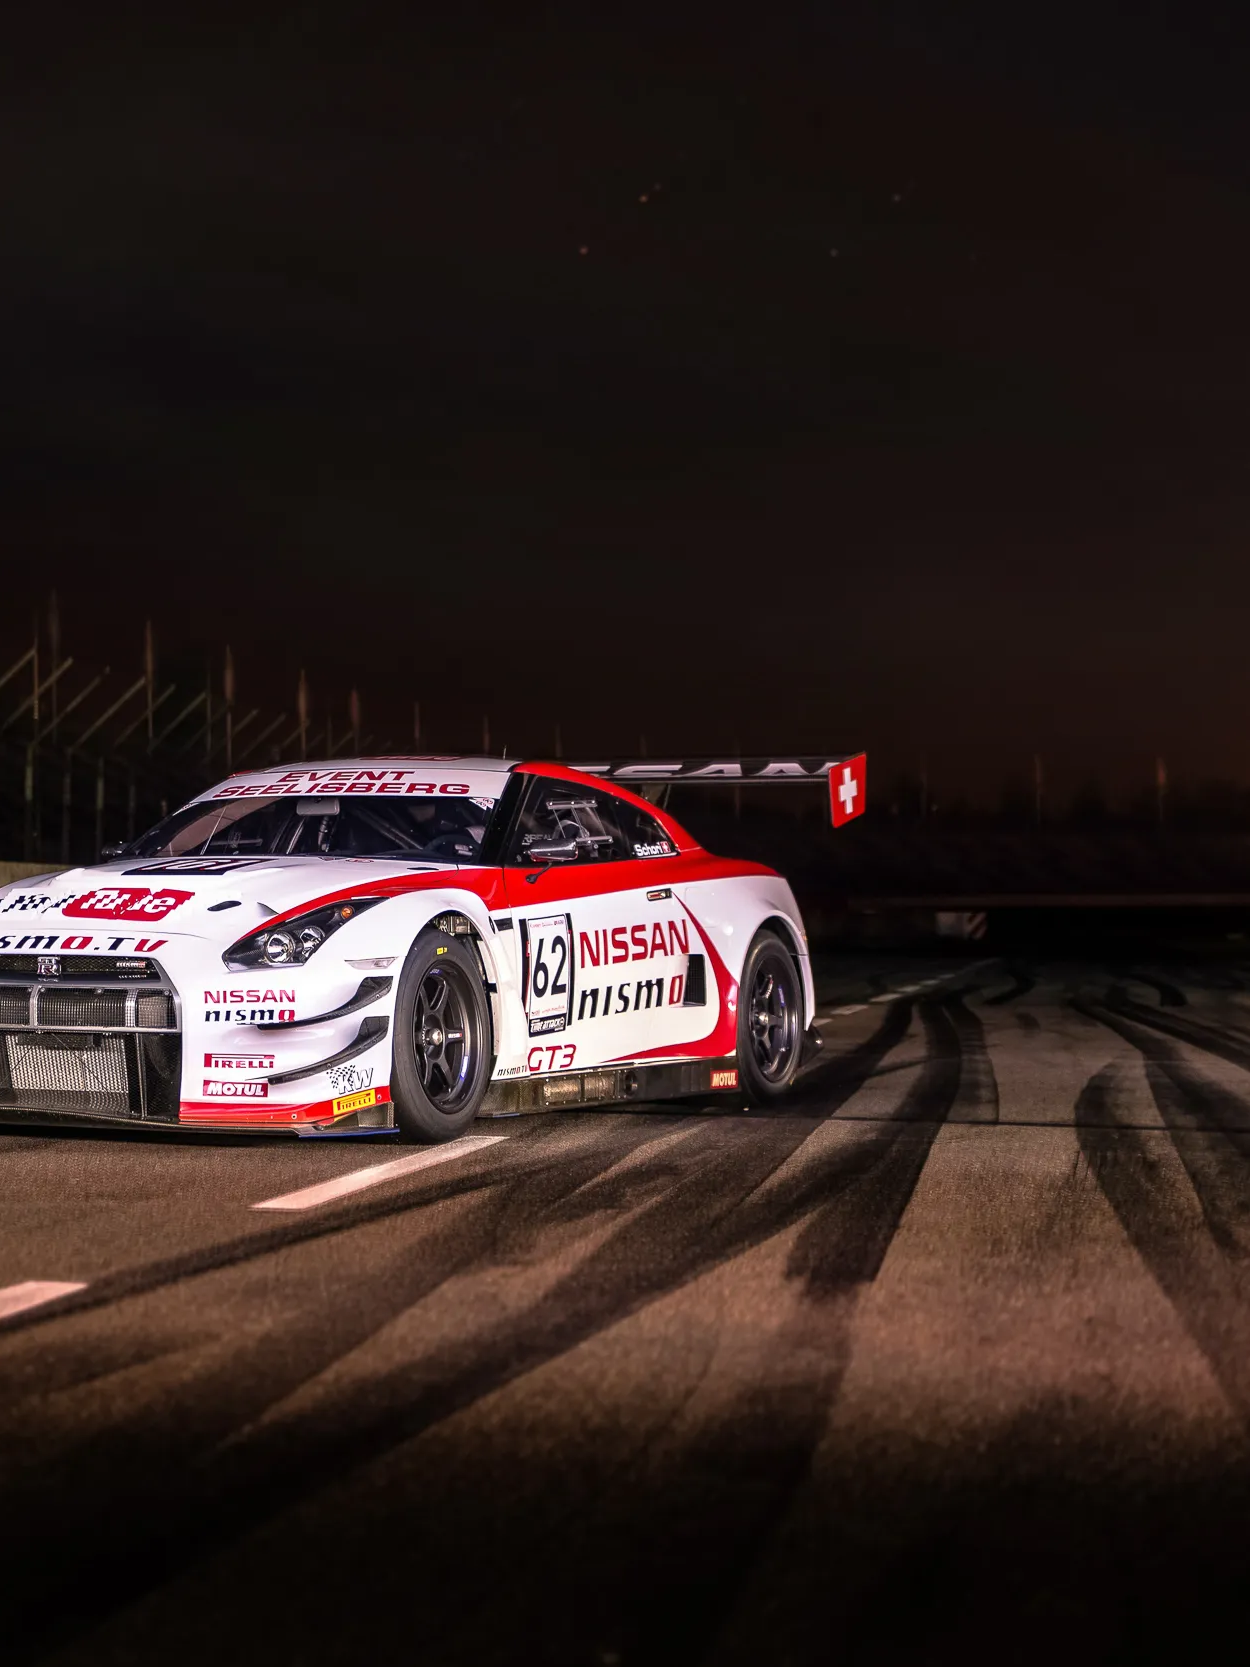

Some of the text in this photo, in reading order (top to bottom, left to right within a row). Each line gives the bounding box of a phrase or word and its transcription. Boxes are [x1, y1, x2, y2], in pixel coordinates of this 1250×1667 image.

[277, 770, 415, 783] EVENT
[212, 782, 470, 798] SEELISBERG
[634, 842, 663, 857] Schori
[579, 919, 690, 968] NISSAN
[532, 935, 567, 998] 62
[204, 989, 296, 1004] NISSAN
[577, 974, 684, 1021] nismo
[204, 1009, 296, 1023] nismo
[204, 1053, 276, 1069] PIRELLI
[527, 1043, 577, 1072] GT3
[338, 1067, 374, 1095] KW
[712, 1072, 737, 1087] MOTUL
[206, 1083, 265, 1097] MOTUL
[337, 1092, 371, 1111] PIRELLI
